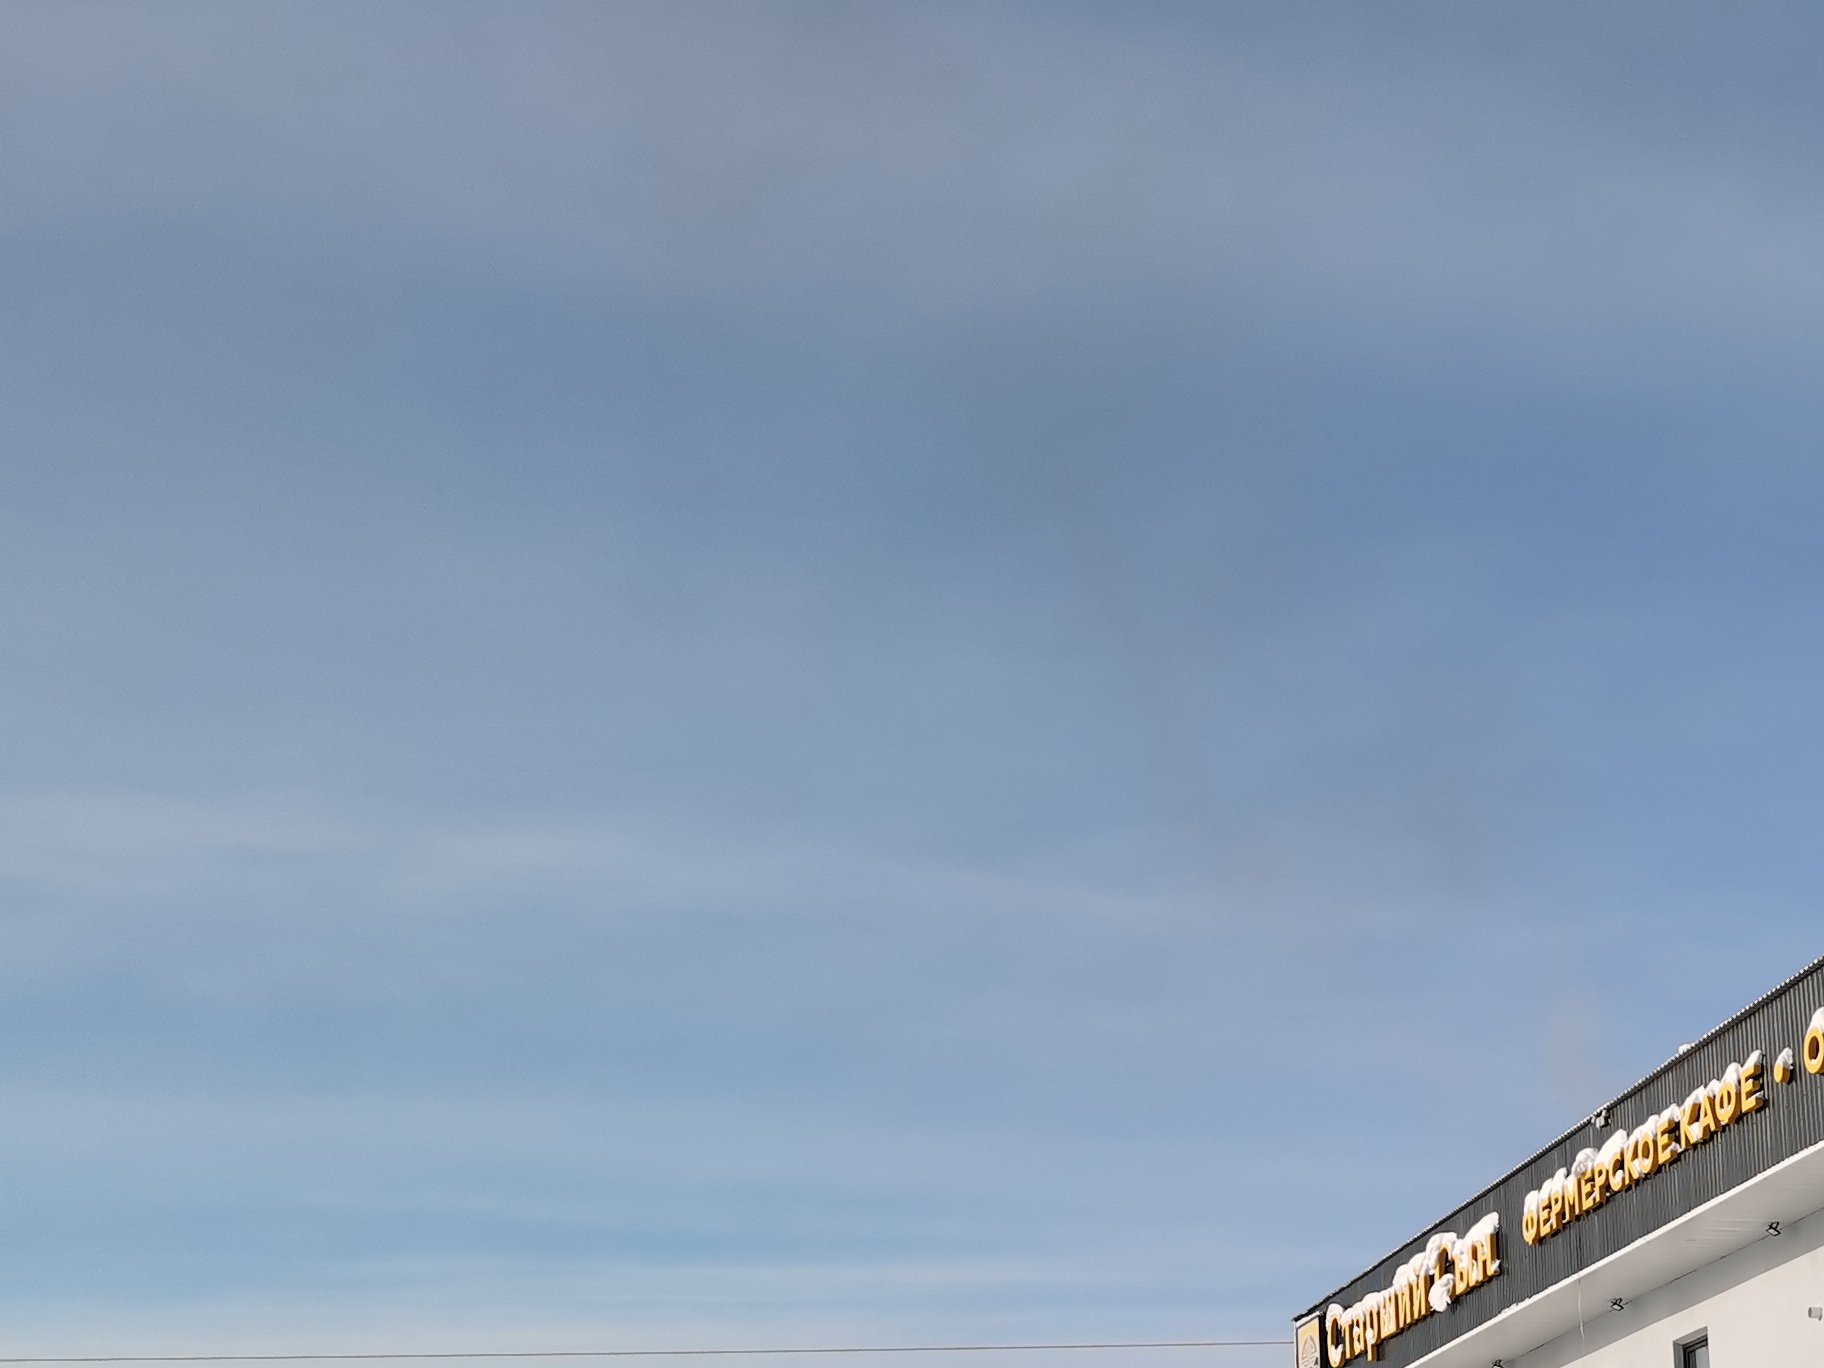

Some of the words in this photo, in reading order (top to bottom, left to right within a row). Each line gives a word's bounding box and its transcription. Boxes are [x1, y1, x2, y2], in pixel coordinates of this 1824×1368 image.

[1327, 1269, 1432, 1368] Старший
[1522, 1118, 1679, 1245] ФЕРМЕРСКОЕ
[1680, 1063, 1764, 1149] КАФЕ
